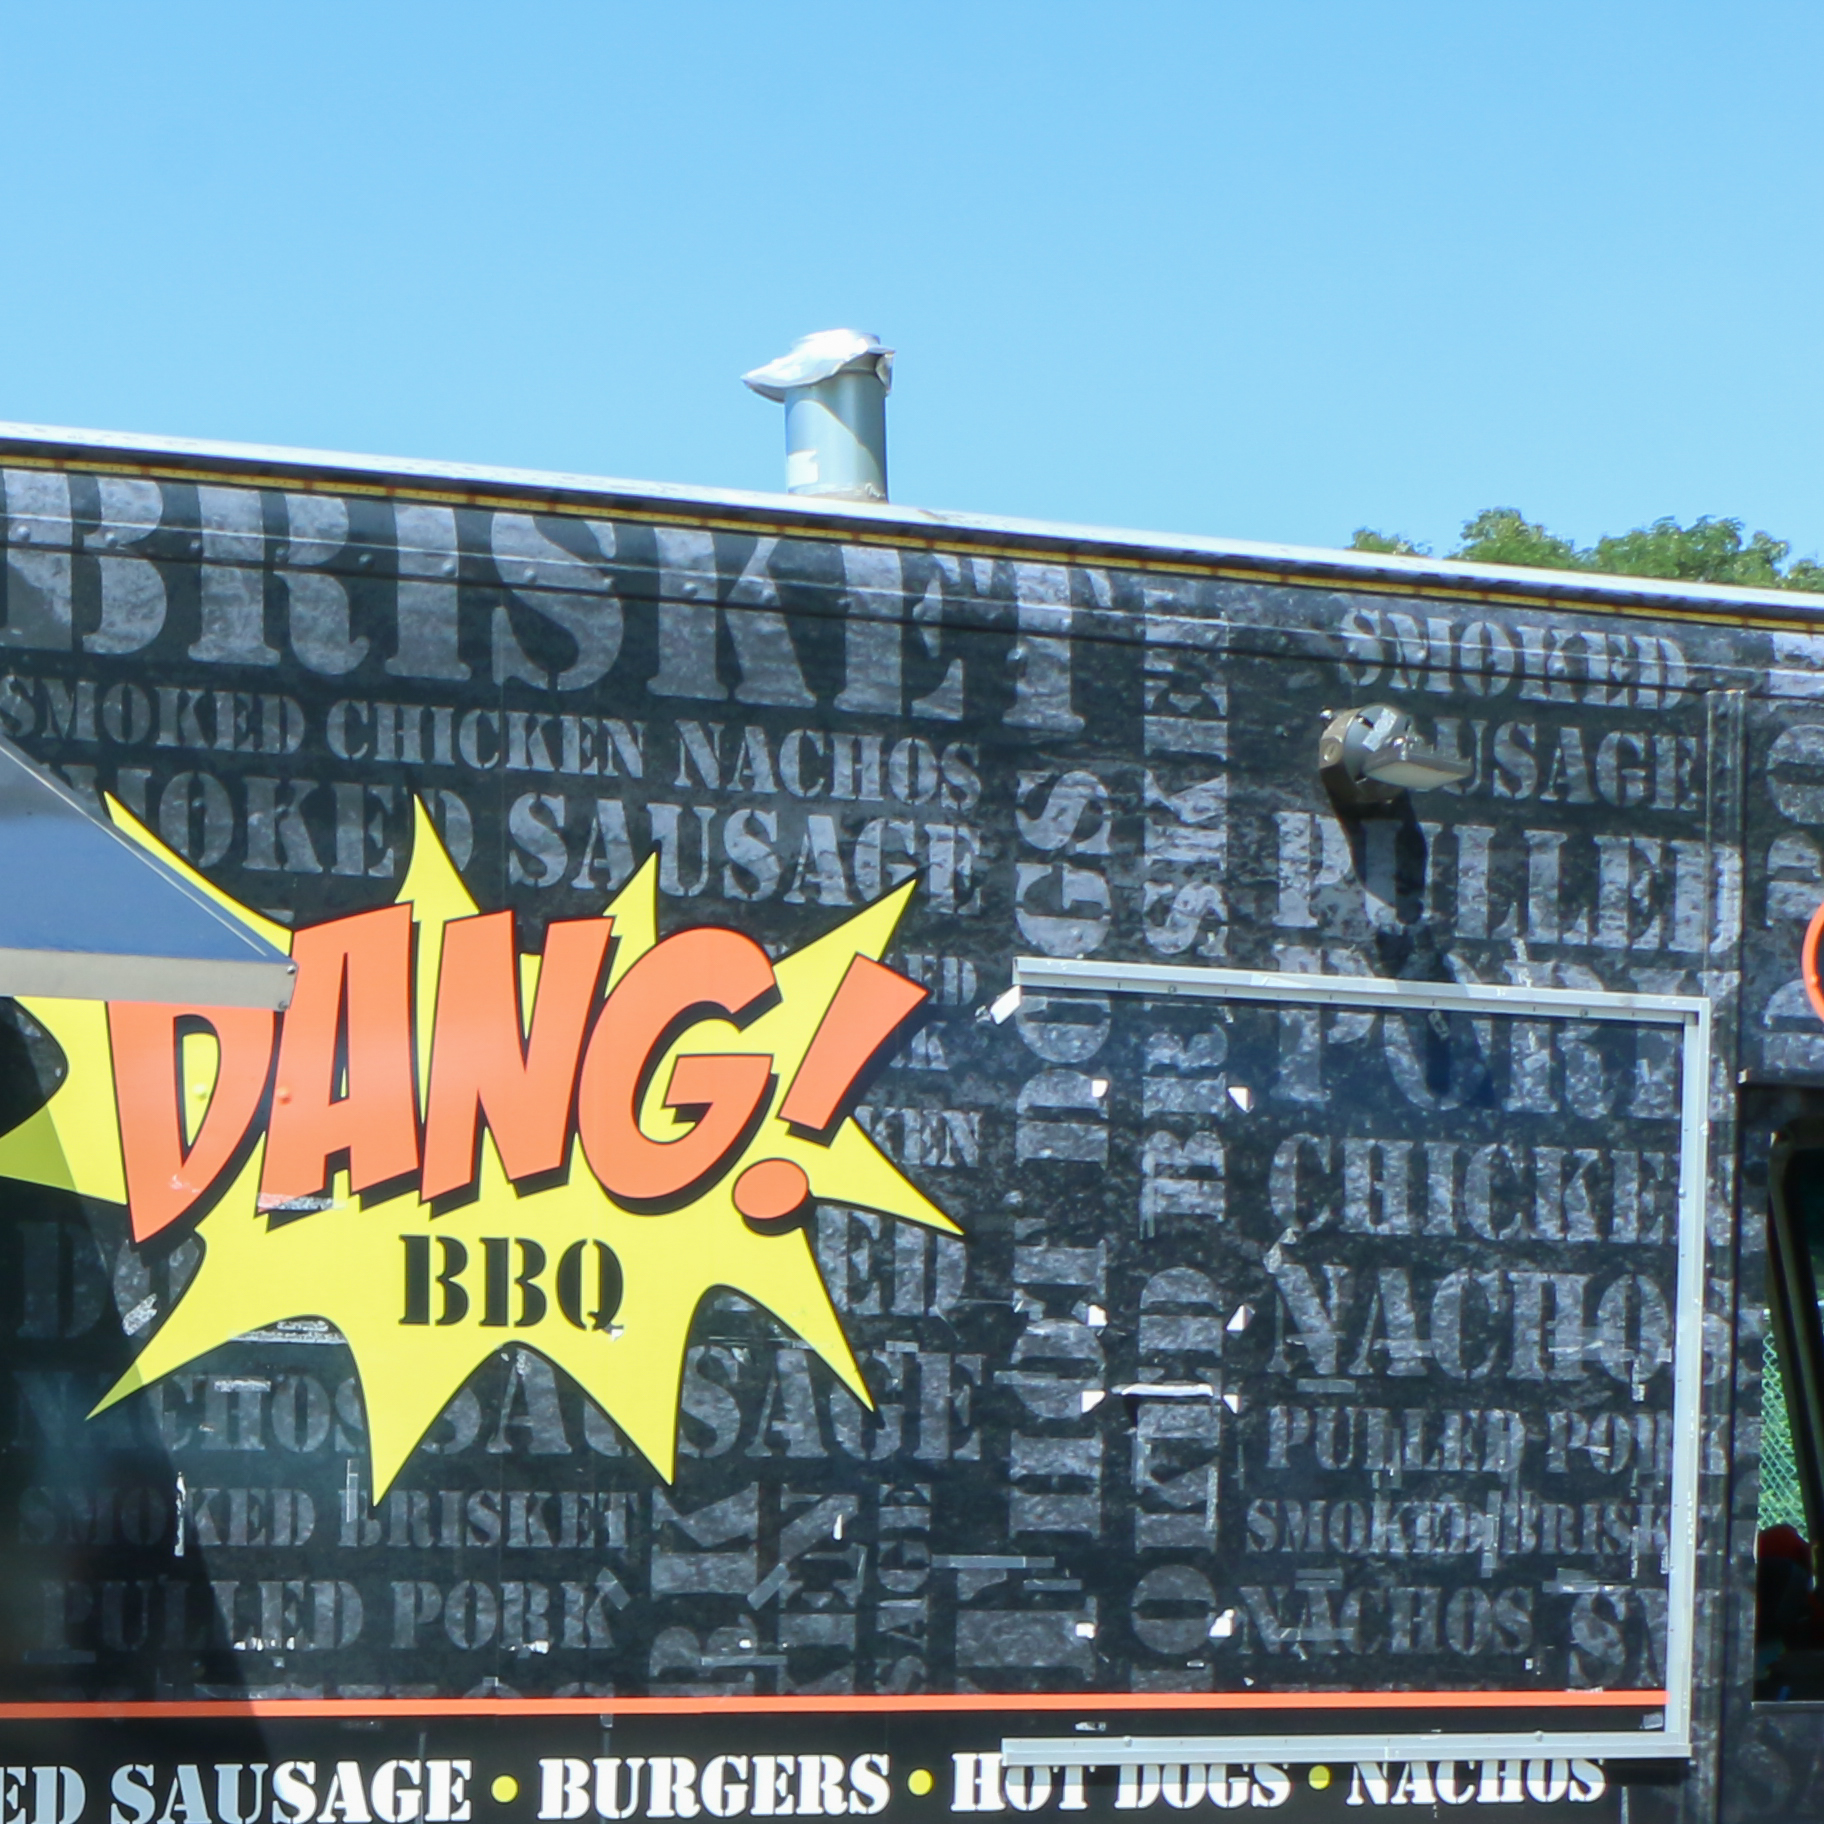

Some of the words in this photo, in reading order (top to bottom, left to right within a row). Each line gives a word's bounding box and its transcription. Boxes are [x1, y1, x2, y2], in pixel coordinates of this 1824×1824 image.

[1339, 607, 1688, 711] SMOKED
[325, 698, 644, 779] CHICKEN
[672, 718, 983, 811] NACHOS
[507, 790, 981, 916] SAUSAGE
[1272, 808, 1742, 954] PULLED
[108, 902, 928, 1247] DANG!
[398, 1233, 626, 1332] BBQ
[389, 1577, 618, 1653] PORK
[1238, 1584, 1535, 1656] NACHOS
[537, 1754, 890, 1822] BURGERS
[950, 1752, 1098, 1814] HOT
[1114, 1760, 1291, 1812] DOGS
[1345, 1756, 1606, 1807] NACHOS
